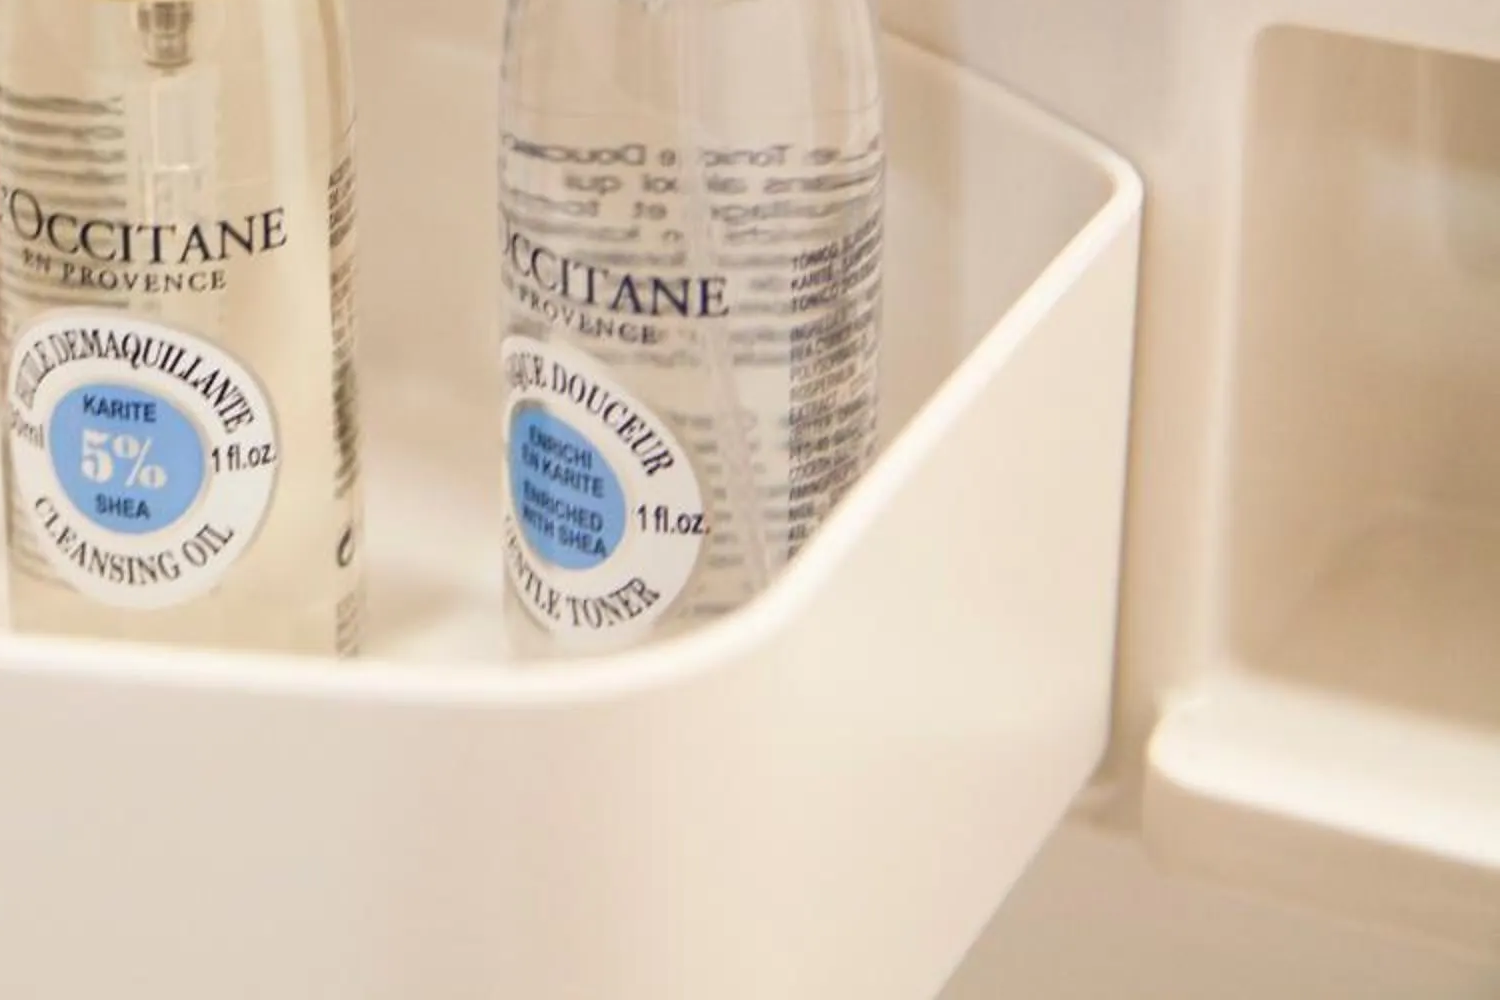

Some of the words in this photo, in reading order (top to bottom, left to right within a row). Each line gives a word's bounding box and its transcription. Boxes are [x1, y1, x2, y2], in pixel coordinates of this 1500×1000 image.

[61, 261, 228, 294] PROVENCE
[505, 218, 729, 318] CCITANE
[518, 283, 660, 346] PROVENCE
[82, 393, 158, 425] KARITE
[551, 360, 676, 477] DOUCEUR
[79, 428, 169, 490] 5%
[211, 446, 221, 474] 1
[527, 423, 594, 472] ENRICHI
[541, 455, 605, 500] KARITE
[94, 493, 153, 521] SHEA
[522, 479, 604, 534] ENRICHED
[637, 503, 648, 532] 1
[33, 495, 181, 587] CLEANSING
[181, 522, 236, 569] OIL
[557, 523, 608, 560] SHEA
[565, 576, 661, 630] TONER
